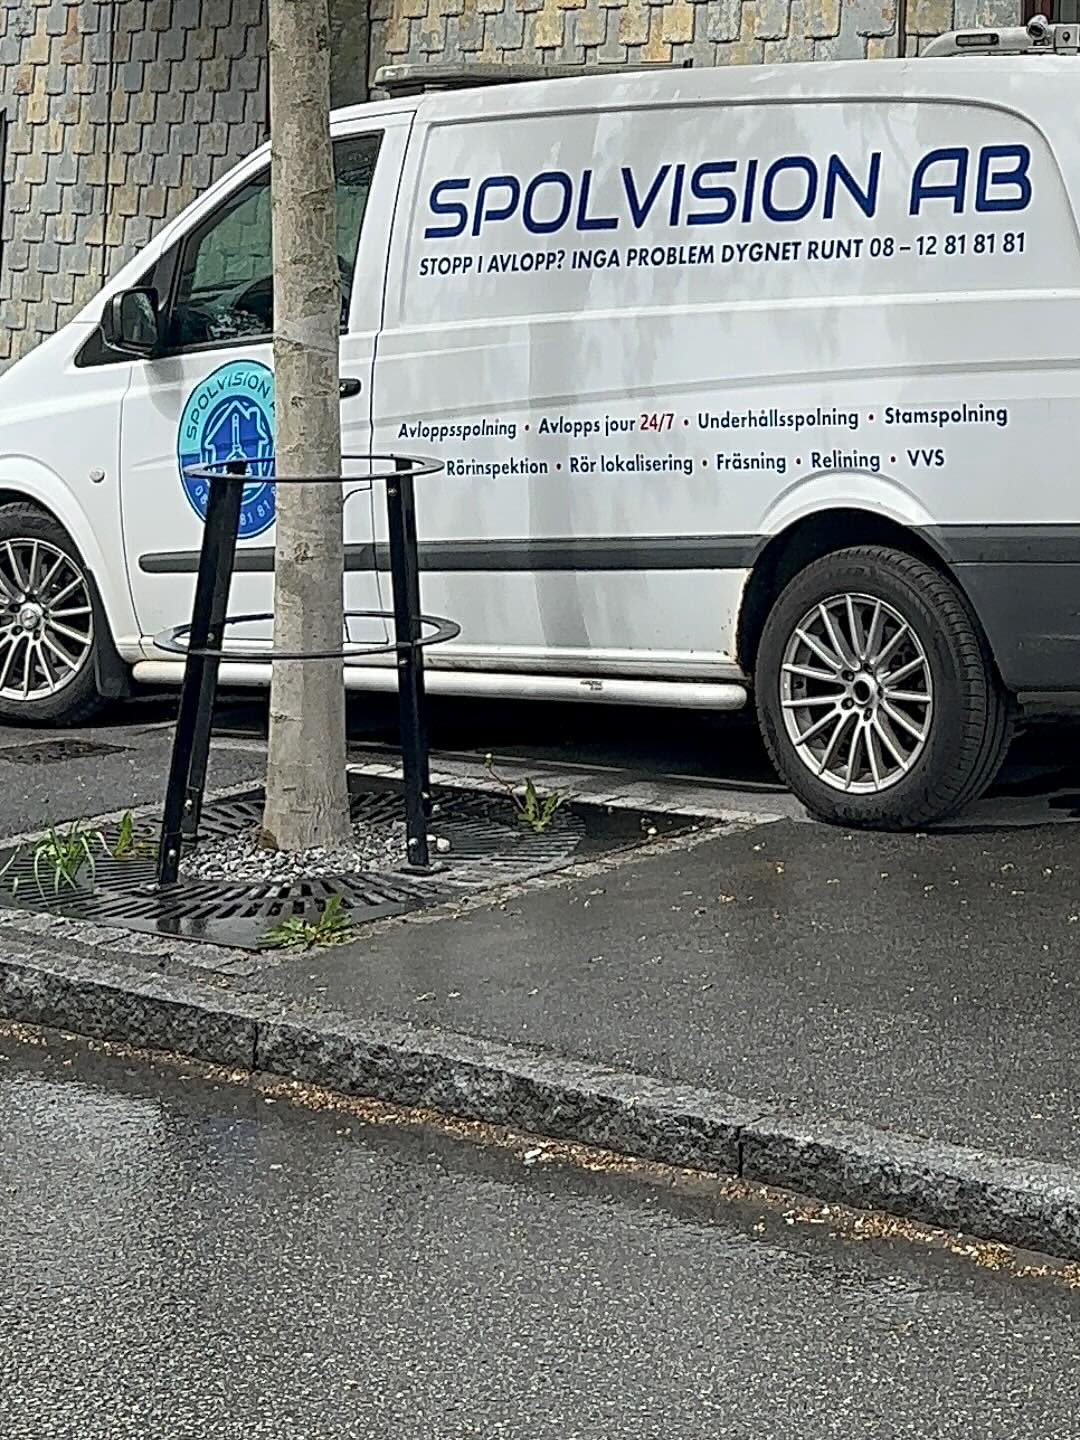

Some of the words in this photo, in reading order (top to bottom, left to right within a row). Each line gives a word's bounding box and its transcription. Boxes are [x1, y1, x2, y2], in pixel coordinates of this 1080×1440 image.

[424, 152, 881, 239] SPOLVISION
[909, 144, 1032, 216] AB
[419, 255, 473, 276] STOPP
[477, 255, 483, 274] I
[487, 249, 566, 273] AVLOPP?
[572, 248, 620, 269] INGA
[626, 244, 714, 267] PROBLEM
[721, 241, 801, 263] DYGNET
[807, 238, 864, 260] RUNT
[869, 237, 894, 257] 08
[915, 235, 937, 256] 12
[944, 234, 967, 254] 81
[973, 233, 996, 253] 81
[1003, 232, 1026, 253] 81
[187, 372, 271, 440] SPOLVISION
[398, 419, 516, 442] Avloppsspolning
[538, 416, 600, 437] Avlopps
[605, 416, 635, 437] jour
[640, 413, 675, 433] 24/7
[698, 408, 859, 431] Underhållsspolning
[884, 403, 1008, 427] Stamspolning
[447, 458, 549, 479] Rörinspektion
[570, 456, 597, 473] Rör
[601, 454, 693, 475] lokalisering
[716, 452, 786, 473] Fräsning
[811, 450, 881, 472] Relining
[907, 449, 944, 467] VVS
[257, 499, 271, 517] 81
